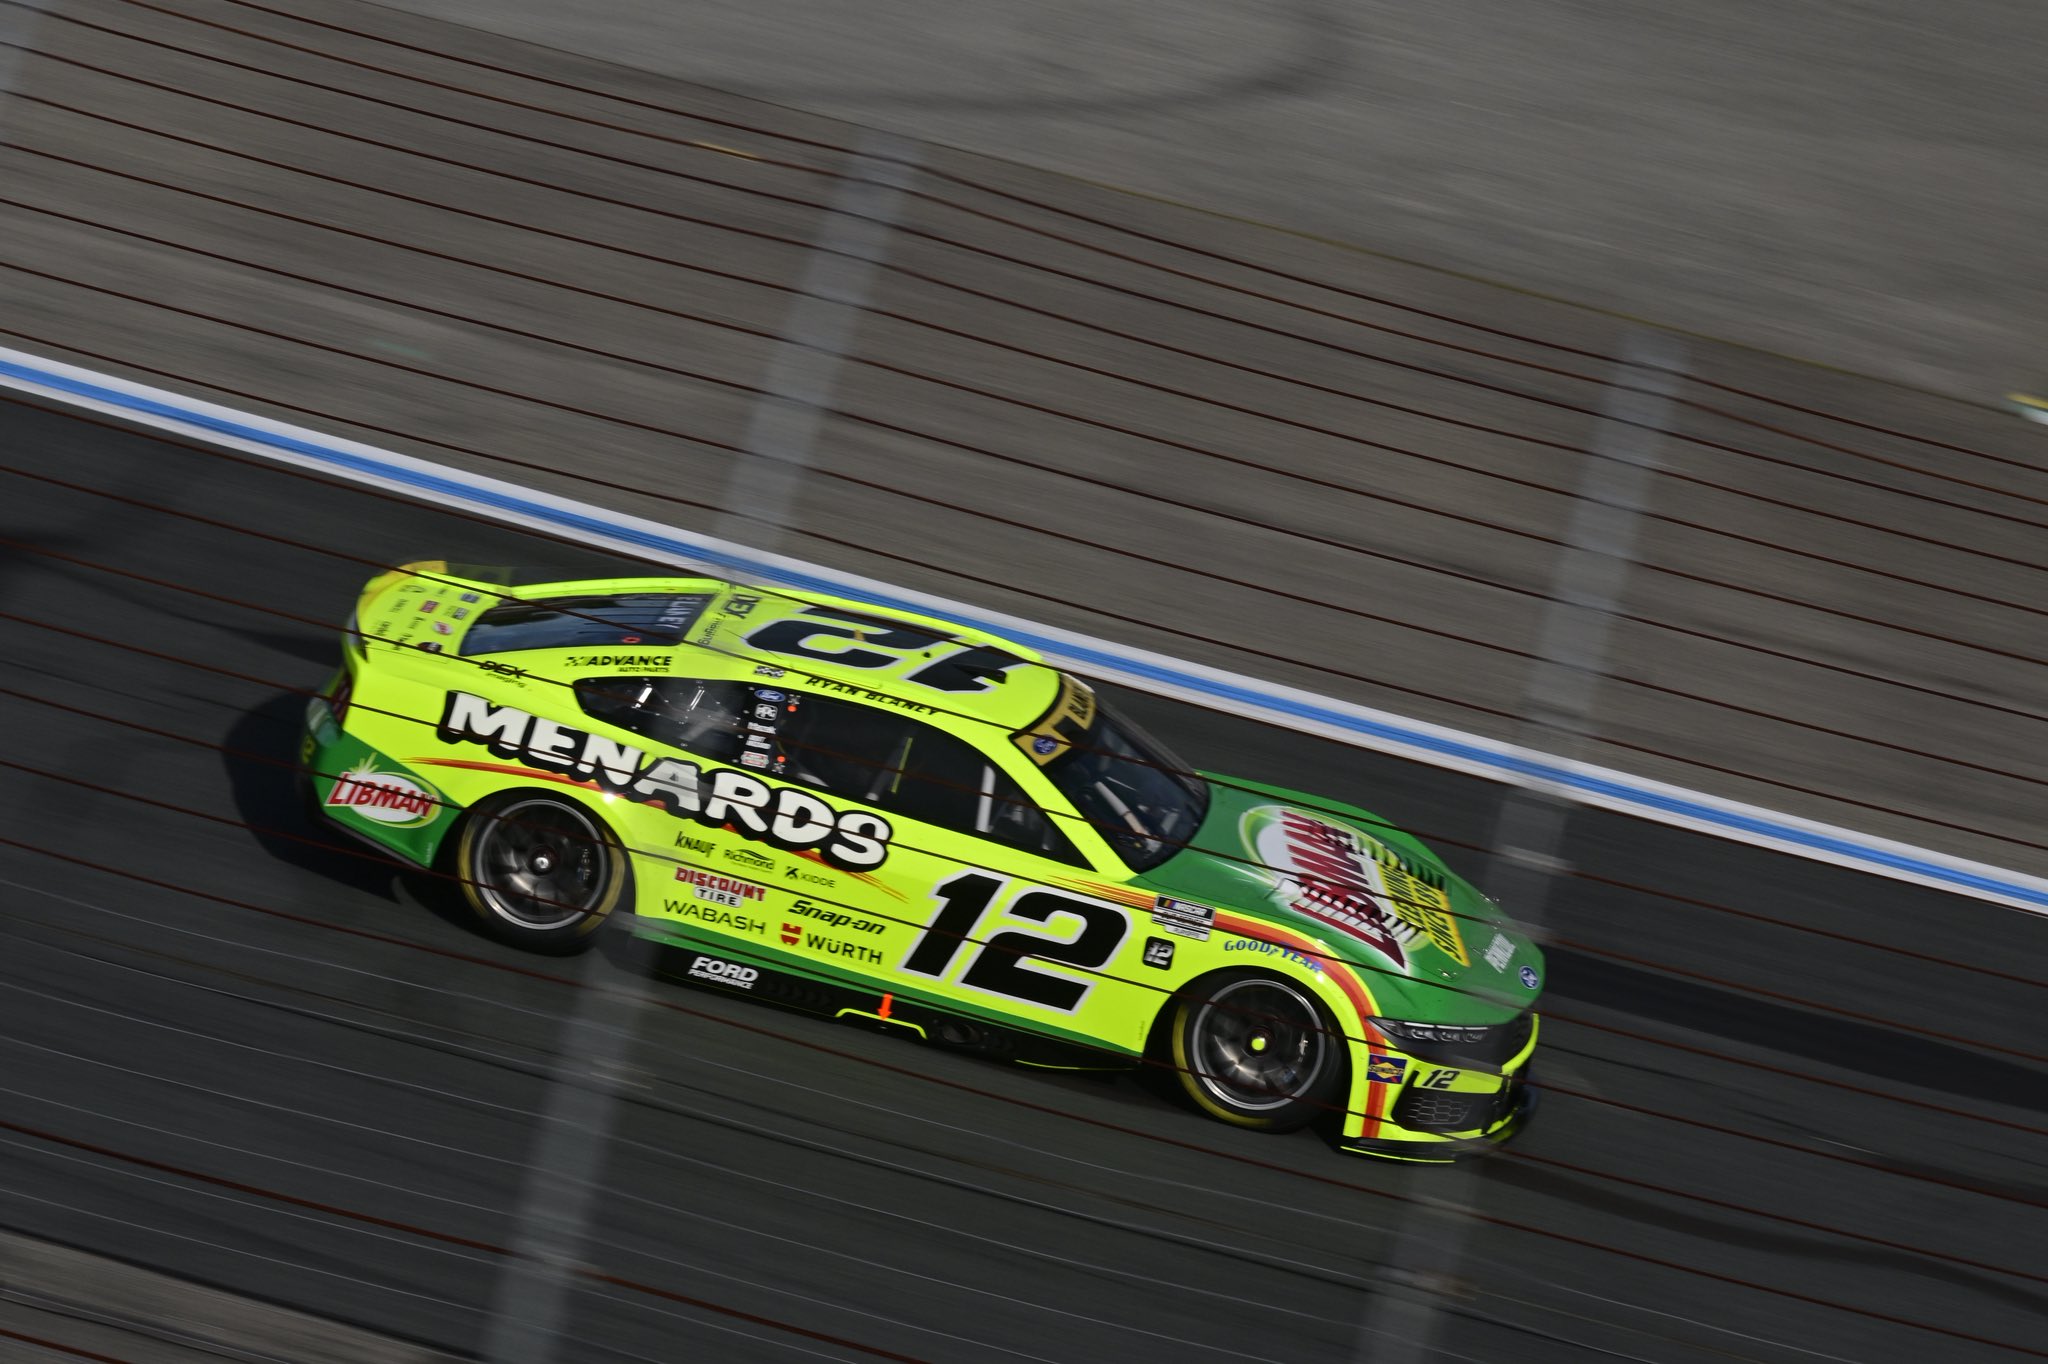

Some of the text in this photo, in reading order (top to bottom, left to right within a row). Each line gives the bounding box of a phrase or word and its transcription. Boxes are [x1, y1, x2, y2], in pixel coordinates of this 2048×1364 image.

[586, 655, 673, 667] ADVANCE
[804, 674, 941, 716] RYAN BLANEY
[326, 772, 437, 817] LIBMAN
[440, 691, 893, 871] MENARDS
[674, 866, 766, 902] DISCOUNT
[700, 888, 737, 907] TIRE
[663, 899, 767, 935] WABASH
[899, 869, 1130, 1015] 12
[687, 968, 755, 990] PERFORMANCE
[691, 956, 760, 982] FORD
[1422, 1069, 1460, 1089] 12
